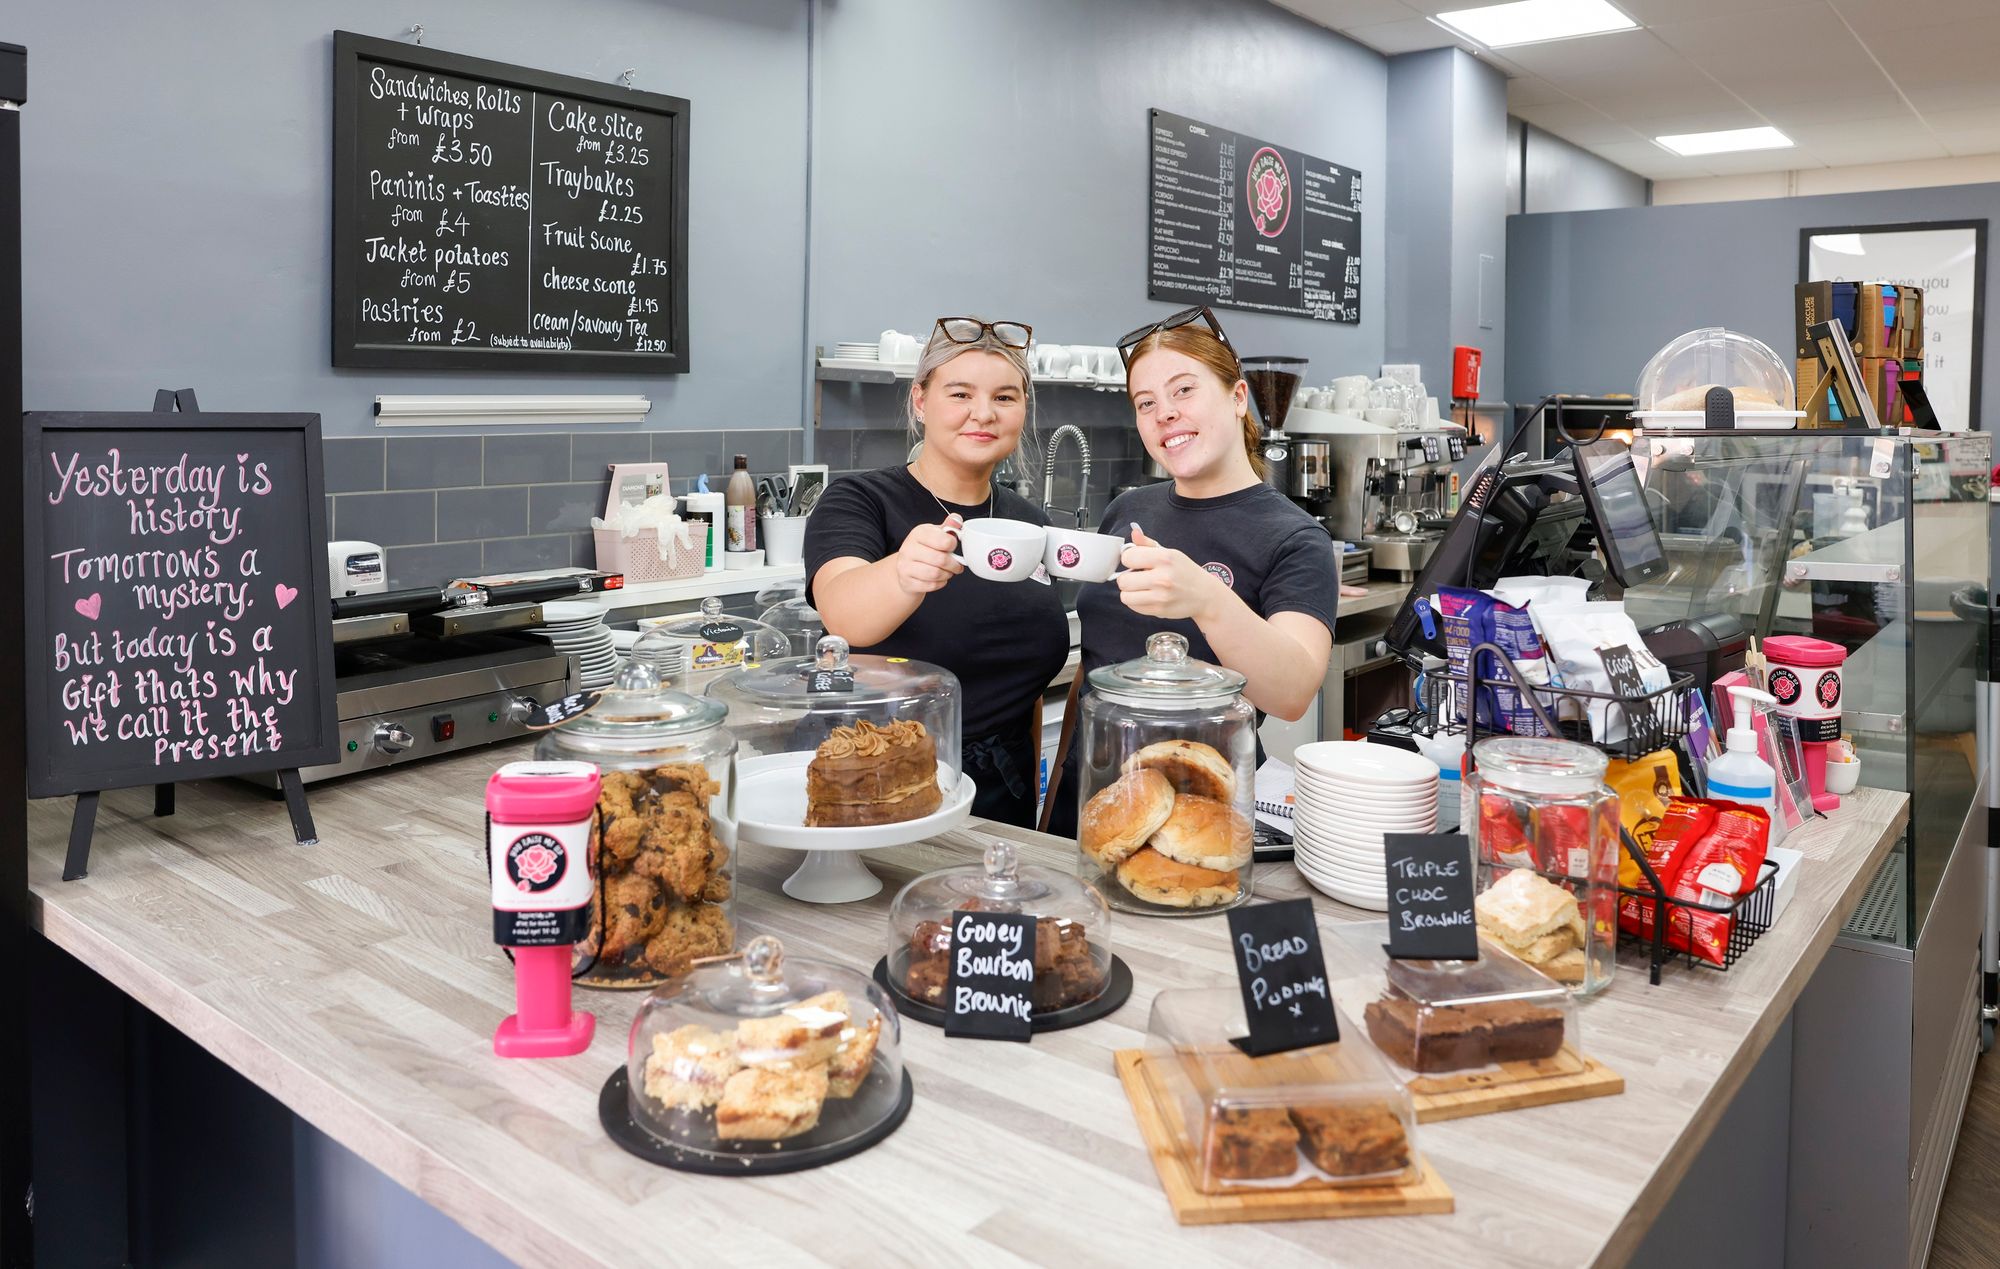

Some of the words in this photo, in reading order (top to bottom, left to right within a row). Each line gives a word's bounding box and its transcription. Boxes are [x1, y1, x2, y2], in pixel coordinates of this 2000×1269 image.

[370, 67, 472, 110] Sandwiches,
[476, 86, 521, 114] Rolls
[397, 103, 409, 120] +
[548, 101, 596, 133] Cake
[388, 128, 420, 149] from
[432, 133, 492, 167] £3.50
[576, 135, 600, 152] from
[604, 139, 649, 166] £3.25
[370, 170, 445, 201] Paninis
[453, 188, 462, 199] +
[465, 181, 530, 210] Toasties
[540, 161, 634, 199] Traybakes
[391, 205, 423, 227] from
[436, 208, 470, 237] £4
[598, 199, 643, 224] £2.25
[543, 222, 585, 249] Fruit
[365, 237, 426, 263] Jacket
[435, 248, 509, 272] potatoes
[631, 253, 667, 275] £1.75
[401, 269, 436, 288] from
[443, 272, 471, 294] £5
[593, 280, 636, 294] scone
[1921, 278, 1950, 292] you
[362, 298, 443, 323] Pastries
[628, 297, 658, 316] £1.95
[408, 323, 440, 342] from
[451, 318, 480, 344] £2
[521, 338, 528, 348] to
[530, 336, 572, 351] availability)
[626, 319, 648, 336] Tea
[49, 448, 226, 510] Yesterday
[238, 453, 272, 495] is
[51, 545, 220, 583] Tomorrow's
[240, 548, 261, 577] a
[55, 632, 103, 671] But
[112, 627, 198, 672] today
[207, 621, 236, 656] is
[253, 625, 273, 652] a
[62, 670, 121, 724] Gift
[135, 669, 217, 704] thats
[118, 706, 169, 740] call
[180, 700, 209, 736] it
[227, 697, 279, 730] the
[1392, 856, 1459, 879] TRIPLE
[1396, 886, 1448, 904] CHOC
[957, 915, 1023, 956] Gooey
[1400, 908, 1472, 931] BROWNIE
[957, 947, 1033, 982] Bourbon
[1240, 933, 1308, 973] BREAD
[955, 986, 1032, 1022] Brownie
[1251, 975, 1326, 1010] PUDDING
